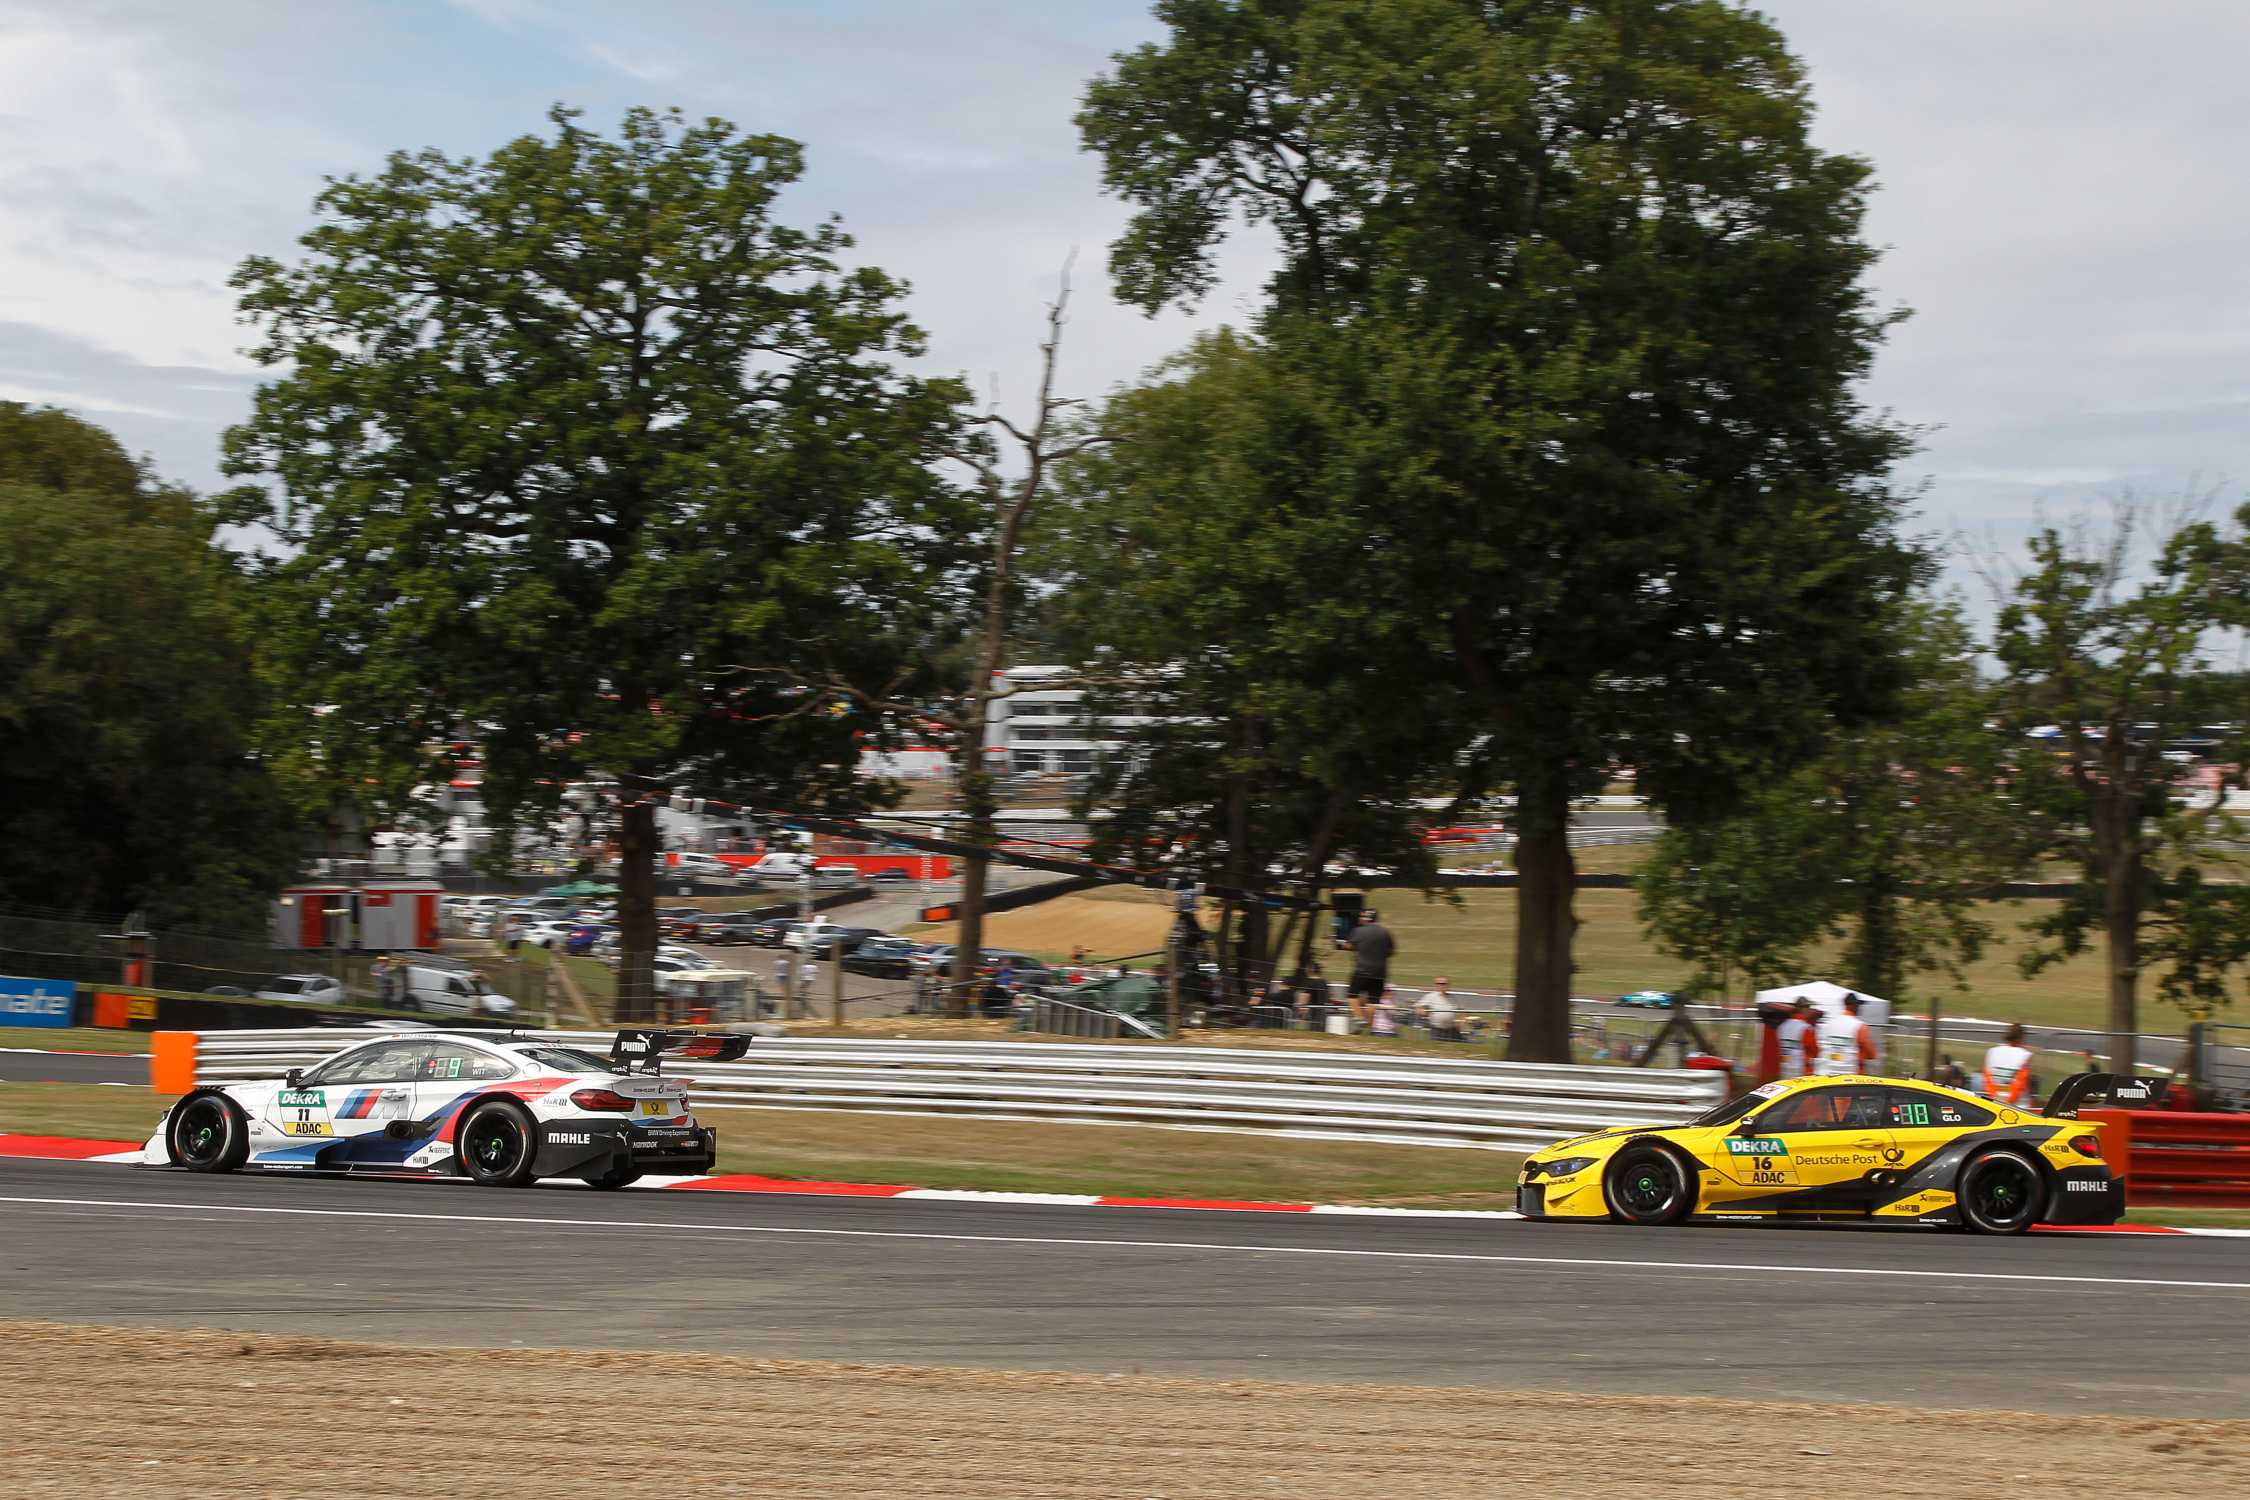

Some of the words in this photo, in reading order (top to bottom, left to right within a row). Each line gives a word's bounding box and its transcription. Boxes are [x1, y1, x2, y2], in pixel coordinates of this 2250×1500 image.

[621, 1041, 646, 1052] PUMA
[281, 1092, 320, 1104] DEKRA
[298, 1109, 310, 1121] 11
[295, 1123, 322, 1134] ADAC
[548, 1133, 591, 1144] MAHLE
[1731, 1141, 1781, 1152] DEKRA
[1753, 1157, 1772, 1170] 16
[1796, 1154, 1849, 1165] Deutsche
[1853, 1154, 1878, 1164] Post
[1753, 1172, 1784, 1183] ADAC
[2067, 1181, 2108, 1192] MAHLE
